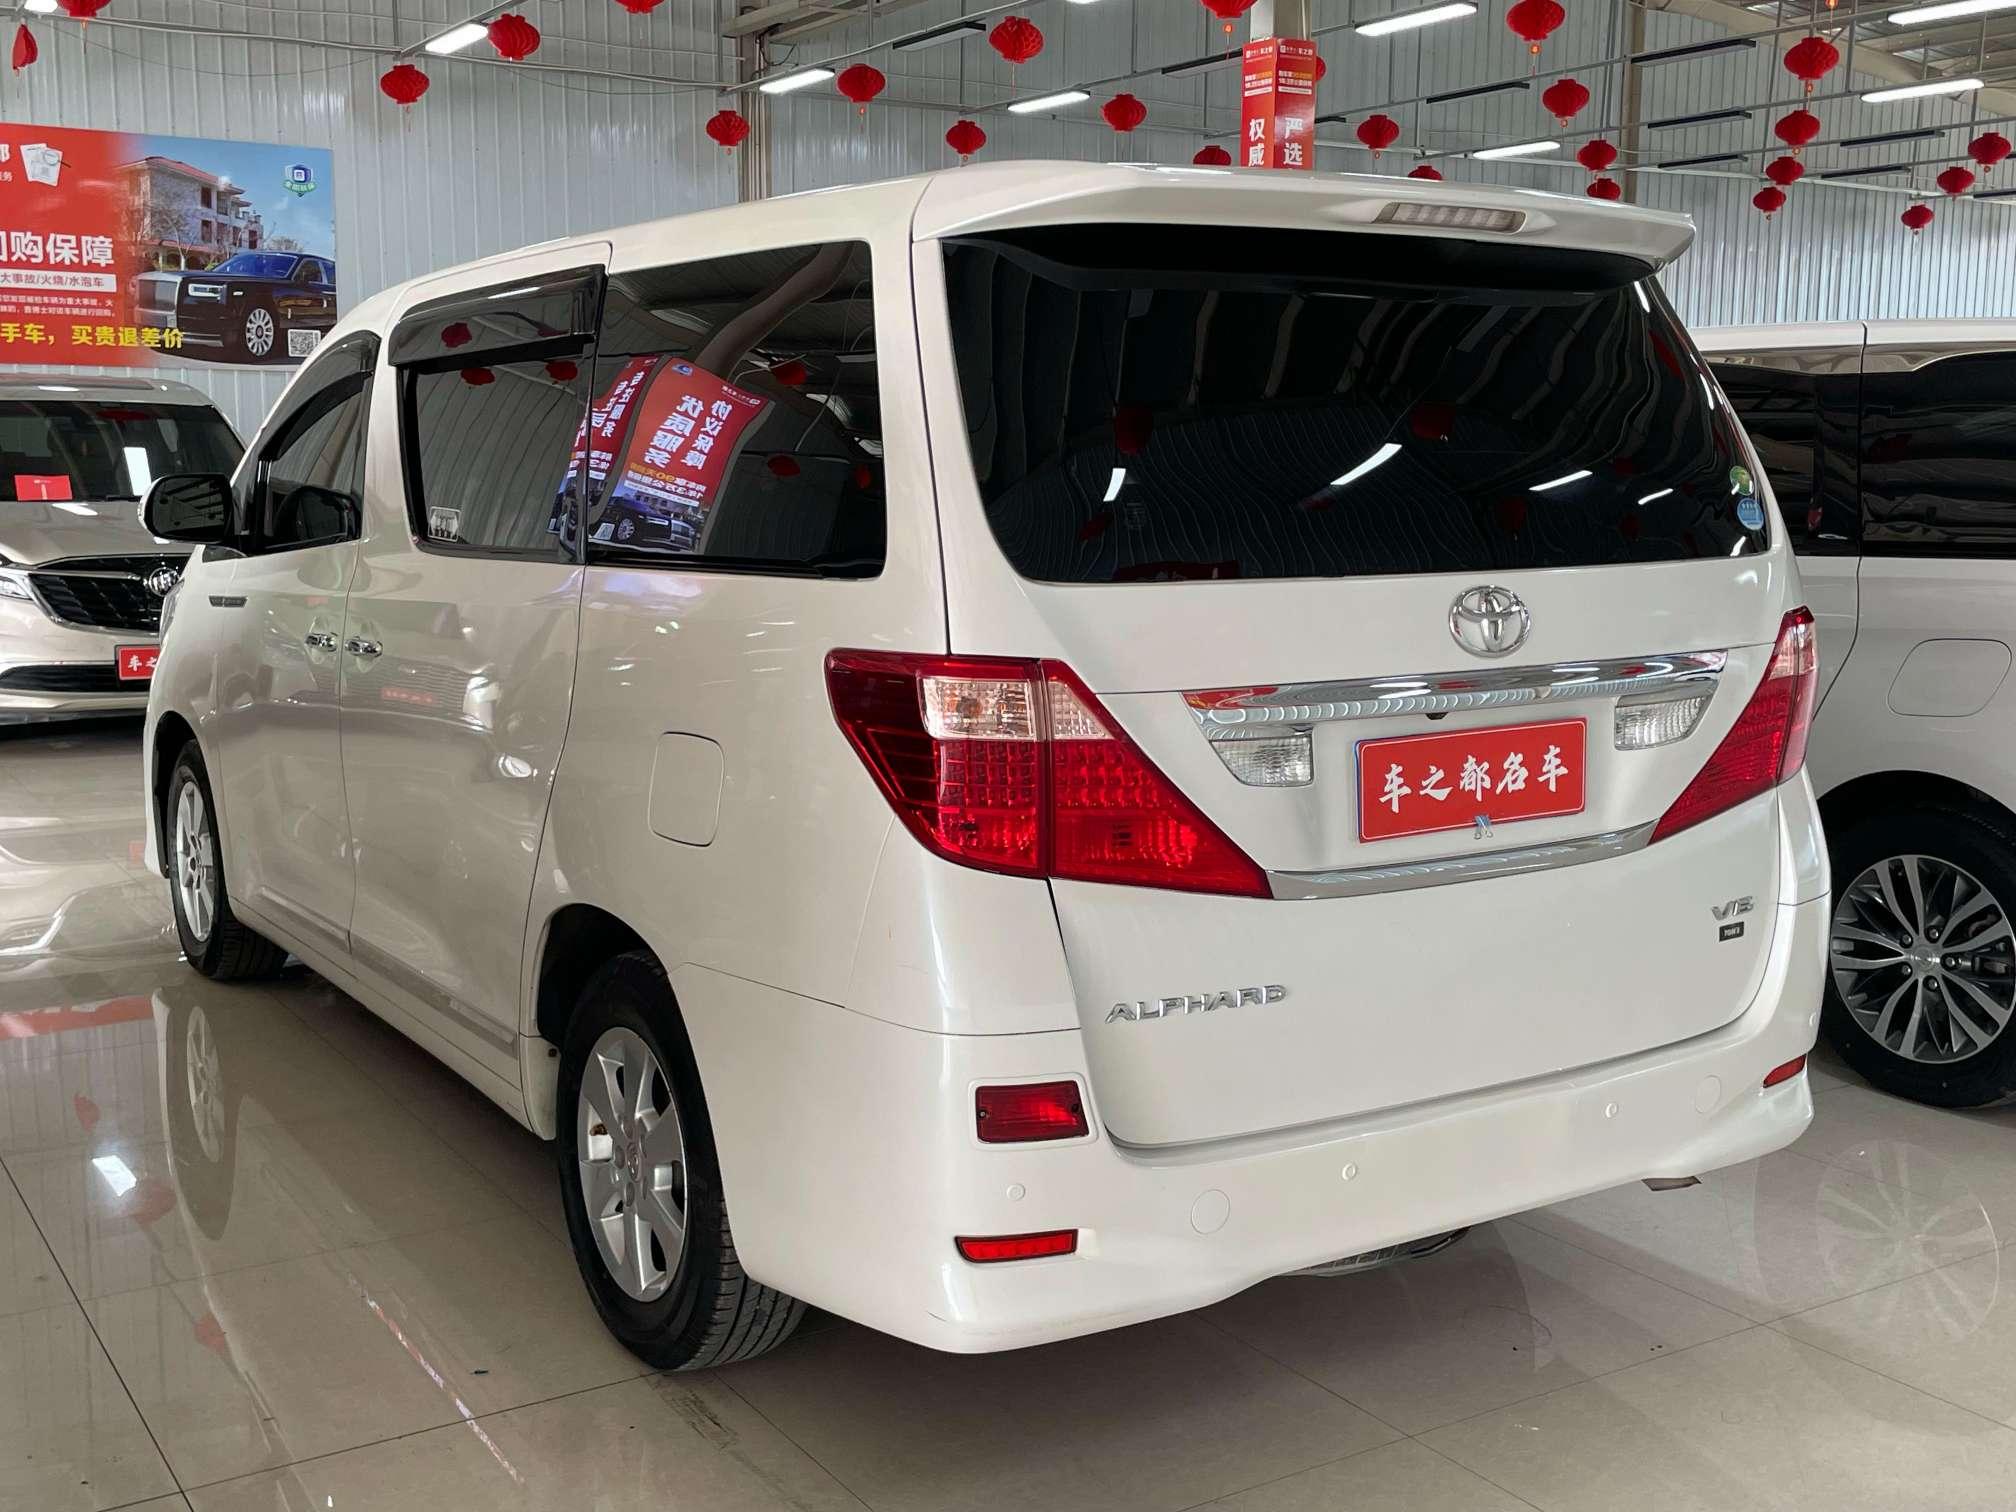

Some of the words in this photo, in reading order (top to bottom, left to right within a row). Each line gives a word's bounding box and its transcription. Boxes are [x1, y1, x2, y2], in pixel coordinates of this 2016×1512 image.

[1249, 118, 1265, 166] 权威
[1283, 117, 1303, 165] 严选
[1378, 745, 1569, 813] 车之都名车
[1105, 985, 1288, 1024] ALPHARD
